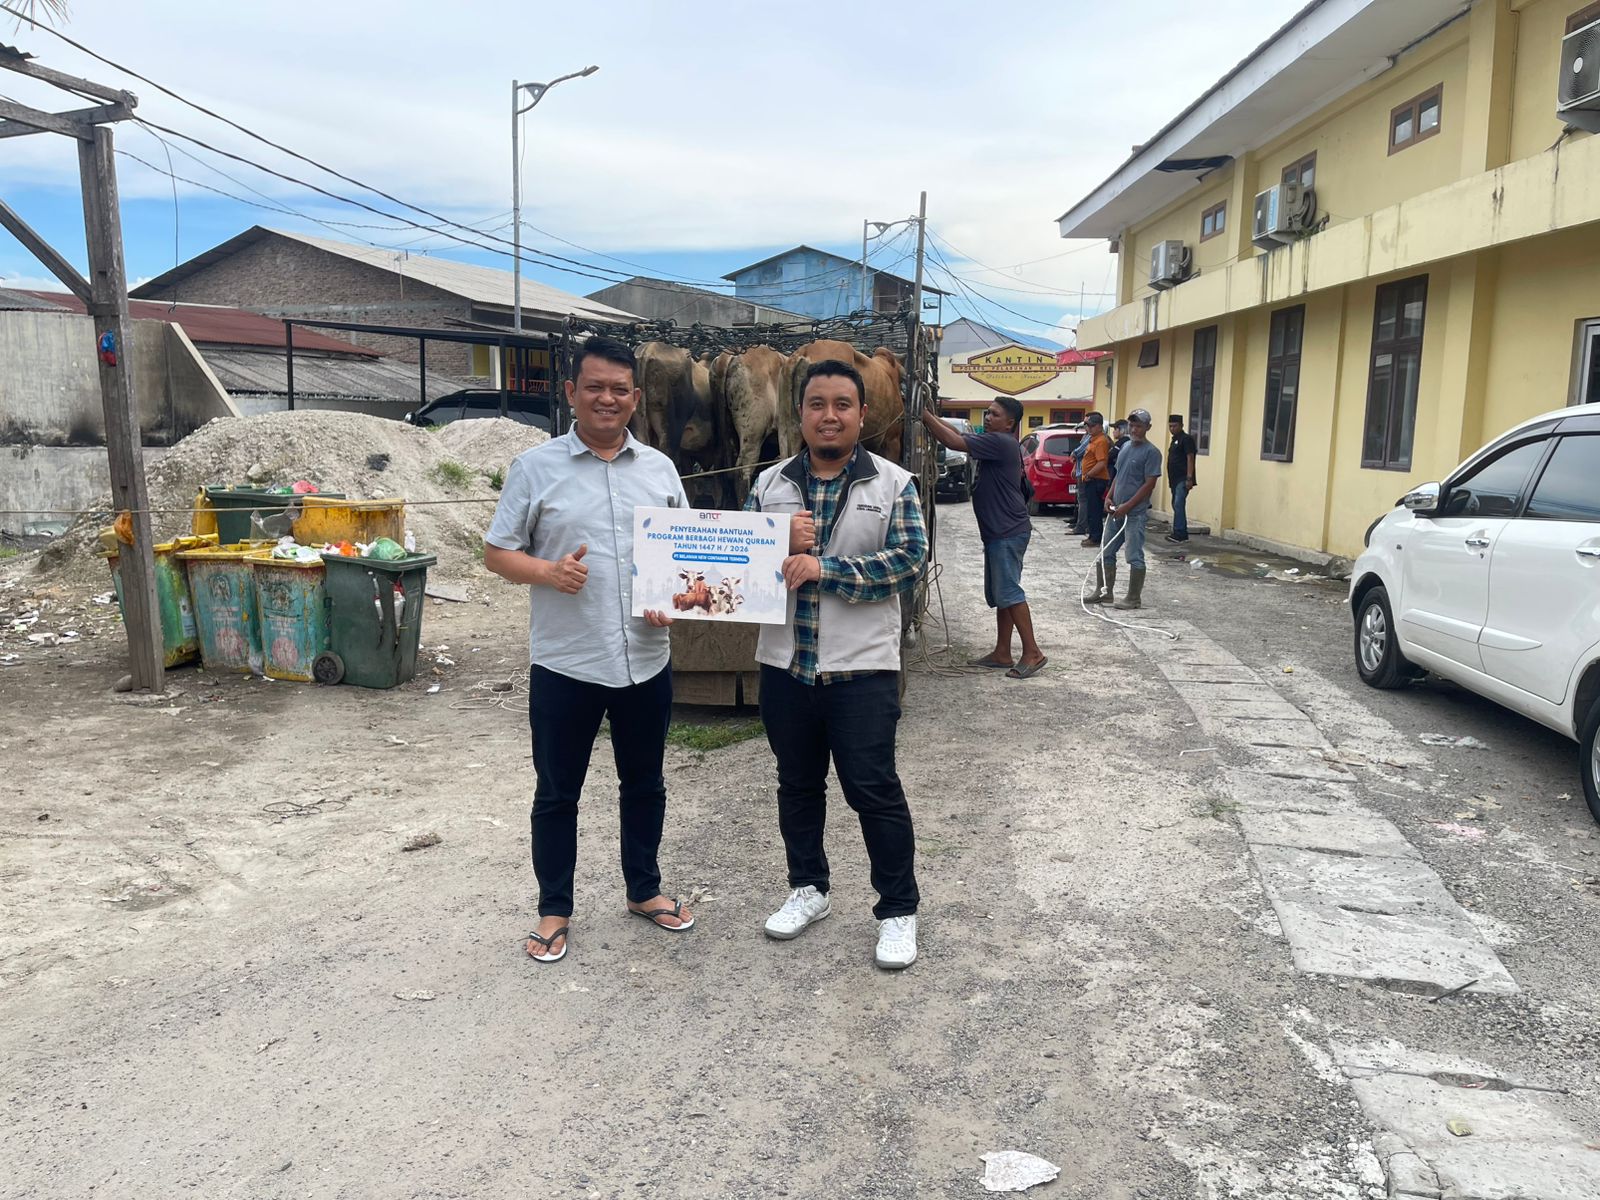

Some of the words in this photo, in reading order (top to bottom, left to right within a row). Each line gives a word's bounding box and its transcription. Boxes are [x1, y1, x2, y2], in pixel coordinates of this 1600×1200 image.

[670, 525, 717, 534] PENYERAHAN
[719, 528, 753, 536] BANTUAN
[647, 532, 684, 541] PROGRAM
[685, 535, 716, 543] BERBAGI
[717, 536, 744, 544] HEWAN
[745, 537, 776, 546] QURBAN
[729, 545, 749, 553] 2026
